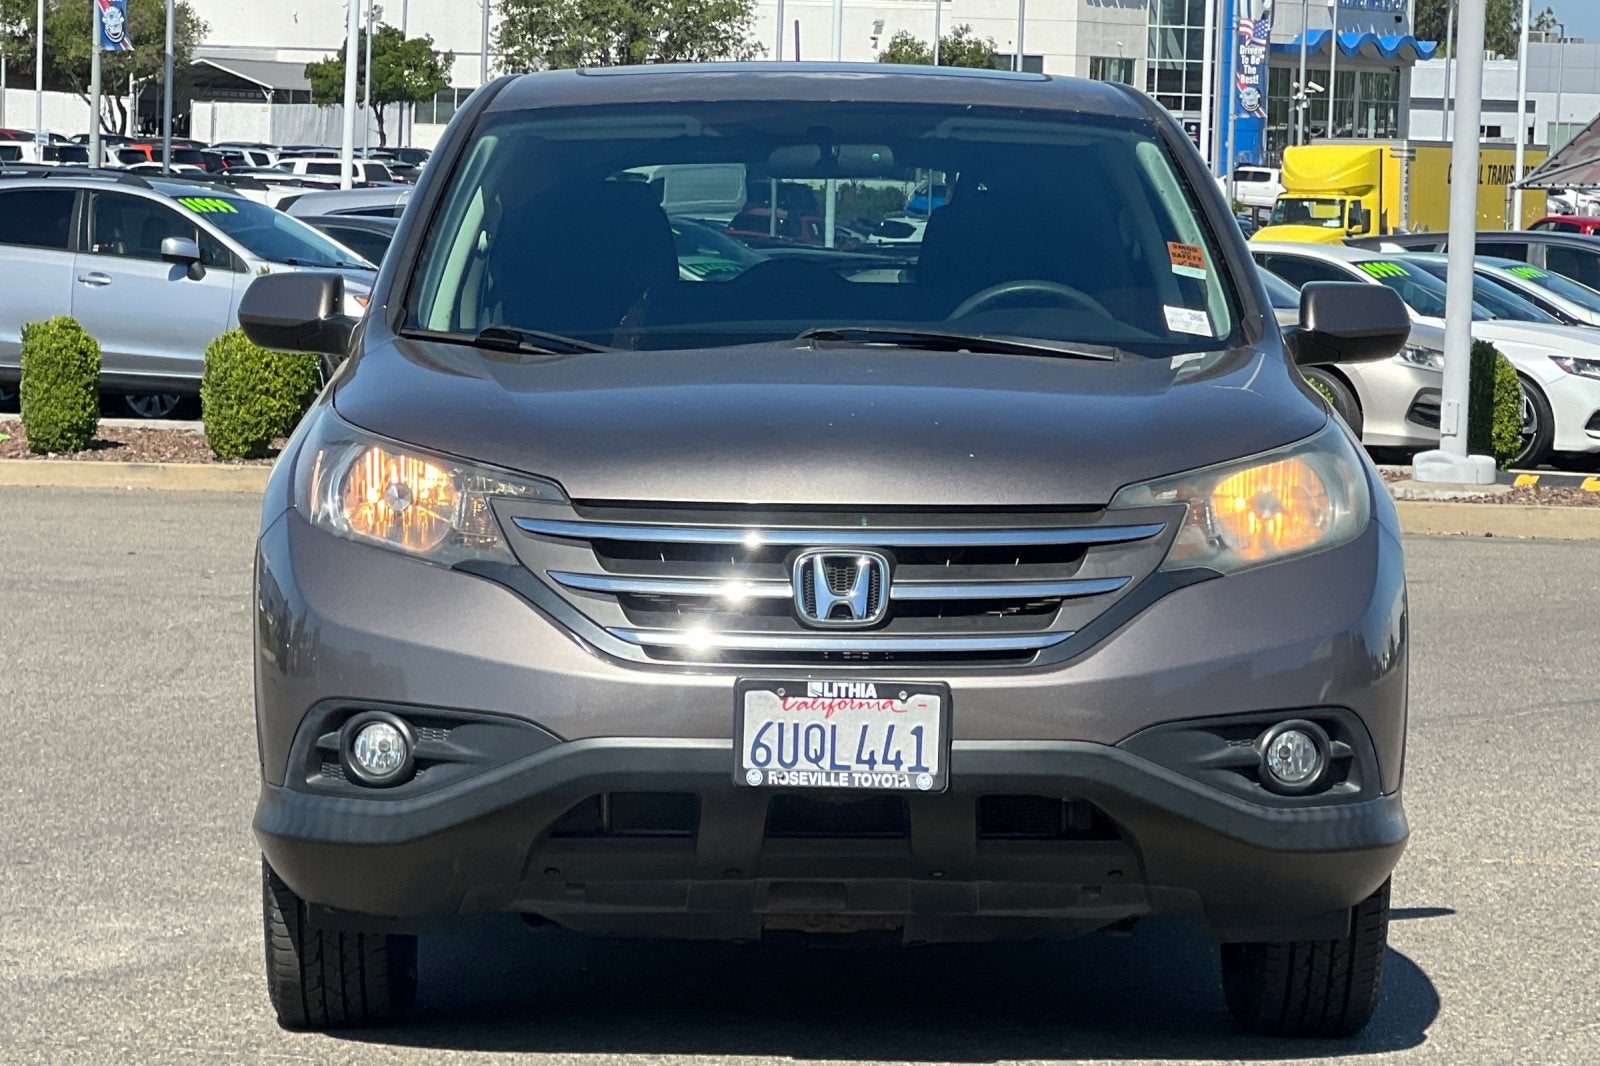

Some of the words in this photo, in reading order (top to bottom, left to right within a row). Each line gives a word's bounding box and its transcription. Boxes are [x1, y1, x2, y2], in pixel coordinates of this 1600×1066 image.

[1240, 45, 1264, 54] Driven
[1241, 55, 1249, 64] To
[1251, 55, 1260, 64] Be
[1244, 65, 1256, 74] The
[1241, 74, 1259, 84] Best!
[823, 681, 878, 699] LITHIA
[781, 697, 908, 719] California
[750, 721, 930, 773] 6UQL441
[768, 771, 849, 787] ROSEVILLE
[852, 773, 911, 788] TOYOTA
